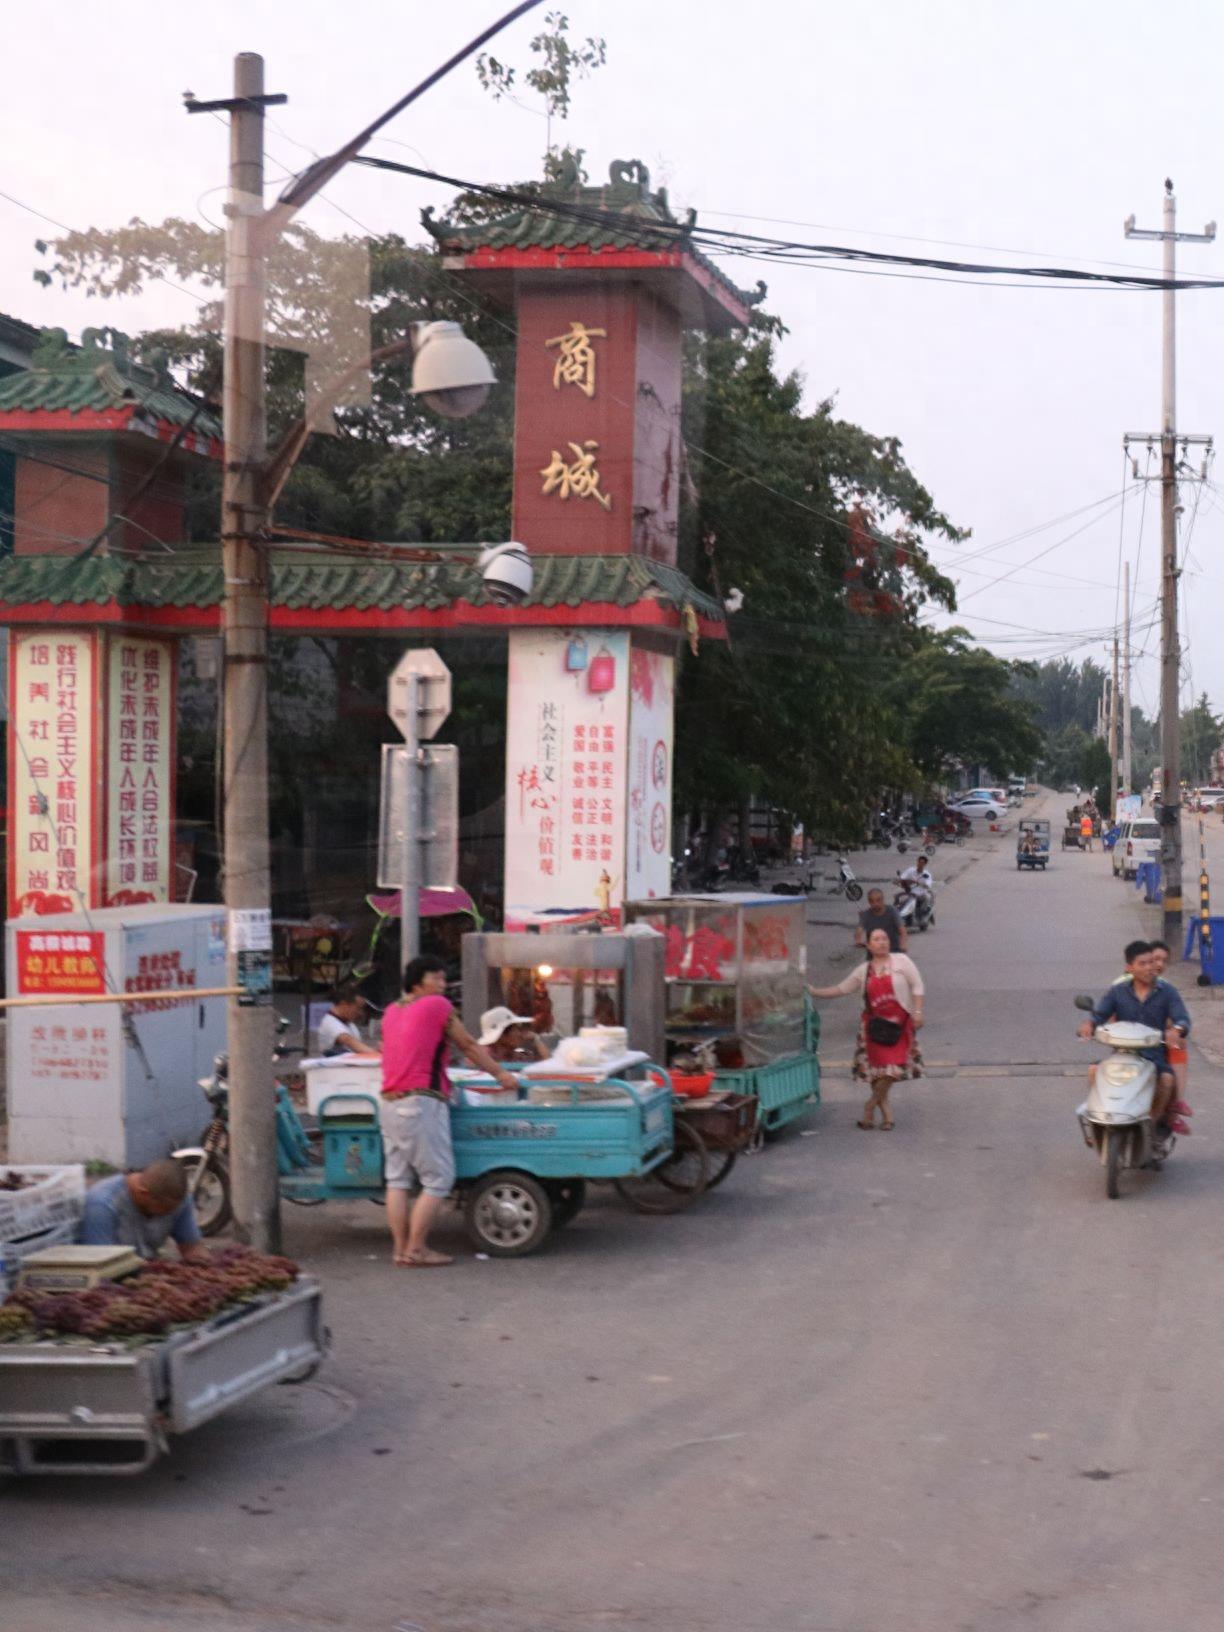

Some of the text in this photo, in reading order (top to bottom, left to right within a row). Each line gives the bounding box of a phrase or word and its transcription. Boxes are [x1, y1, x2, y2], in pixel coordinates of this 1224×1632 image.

[540, 322, 611, 510] 商城
[56, 644, 77, 892] 践行社会主义核心价值观
[120, 648, 138, 885] 优化未成年人成长环境
[142, 648, 160, 883] 维护未成年人合法权益
[571, 725, 586, 861] 爱国 敬业 诚信 友善
[587, 725, 599, 861] 自由 平等 公正 法治
[602, 797, 613, 825] 文明
[603, 761, 613, 788] 民主
[601, 833, 613, 861] 和谐
